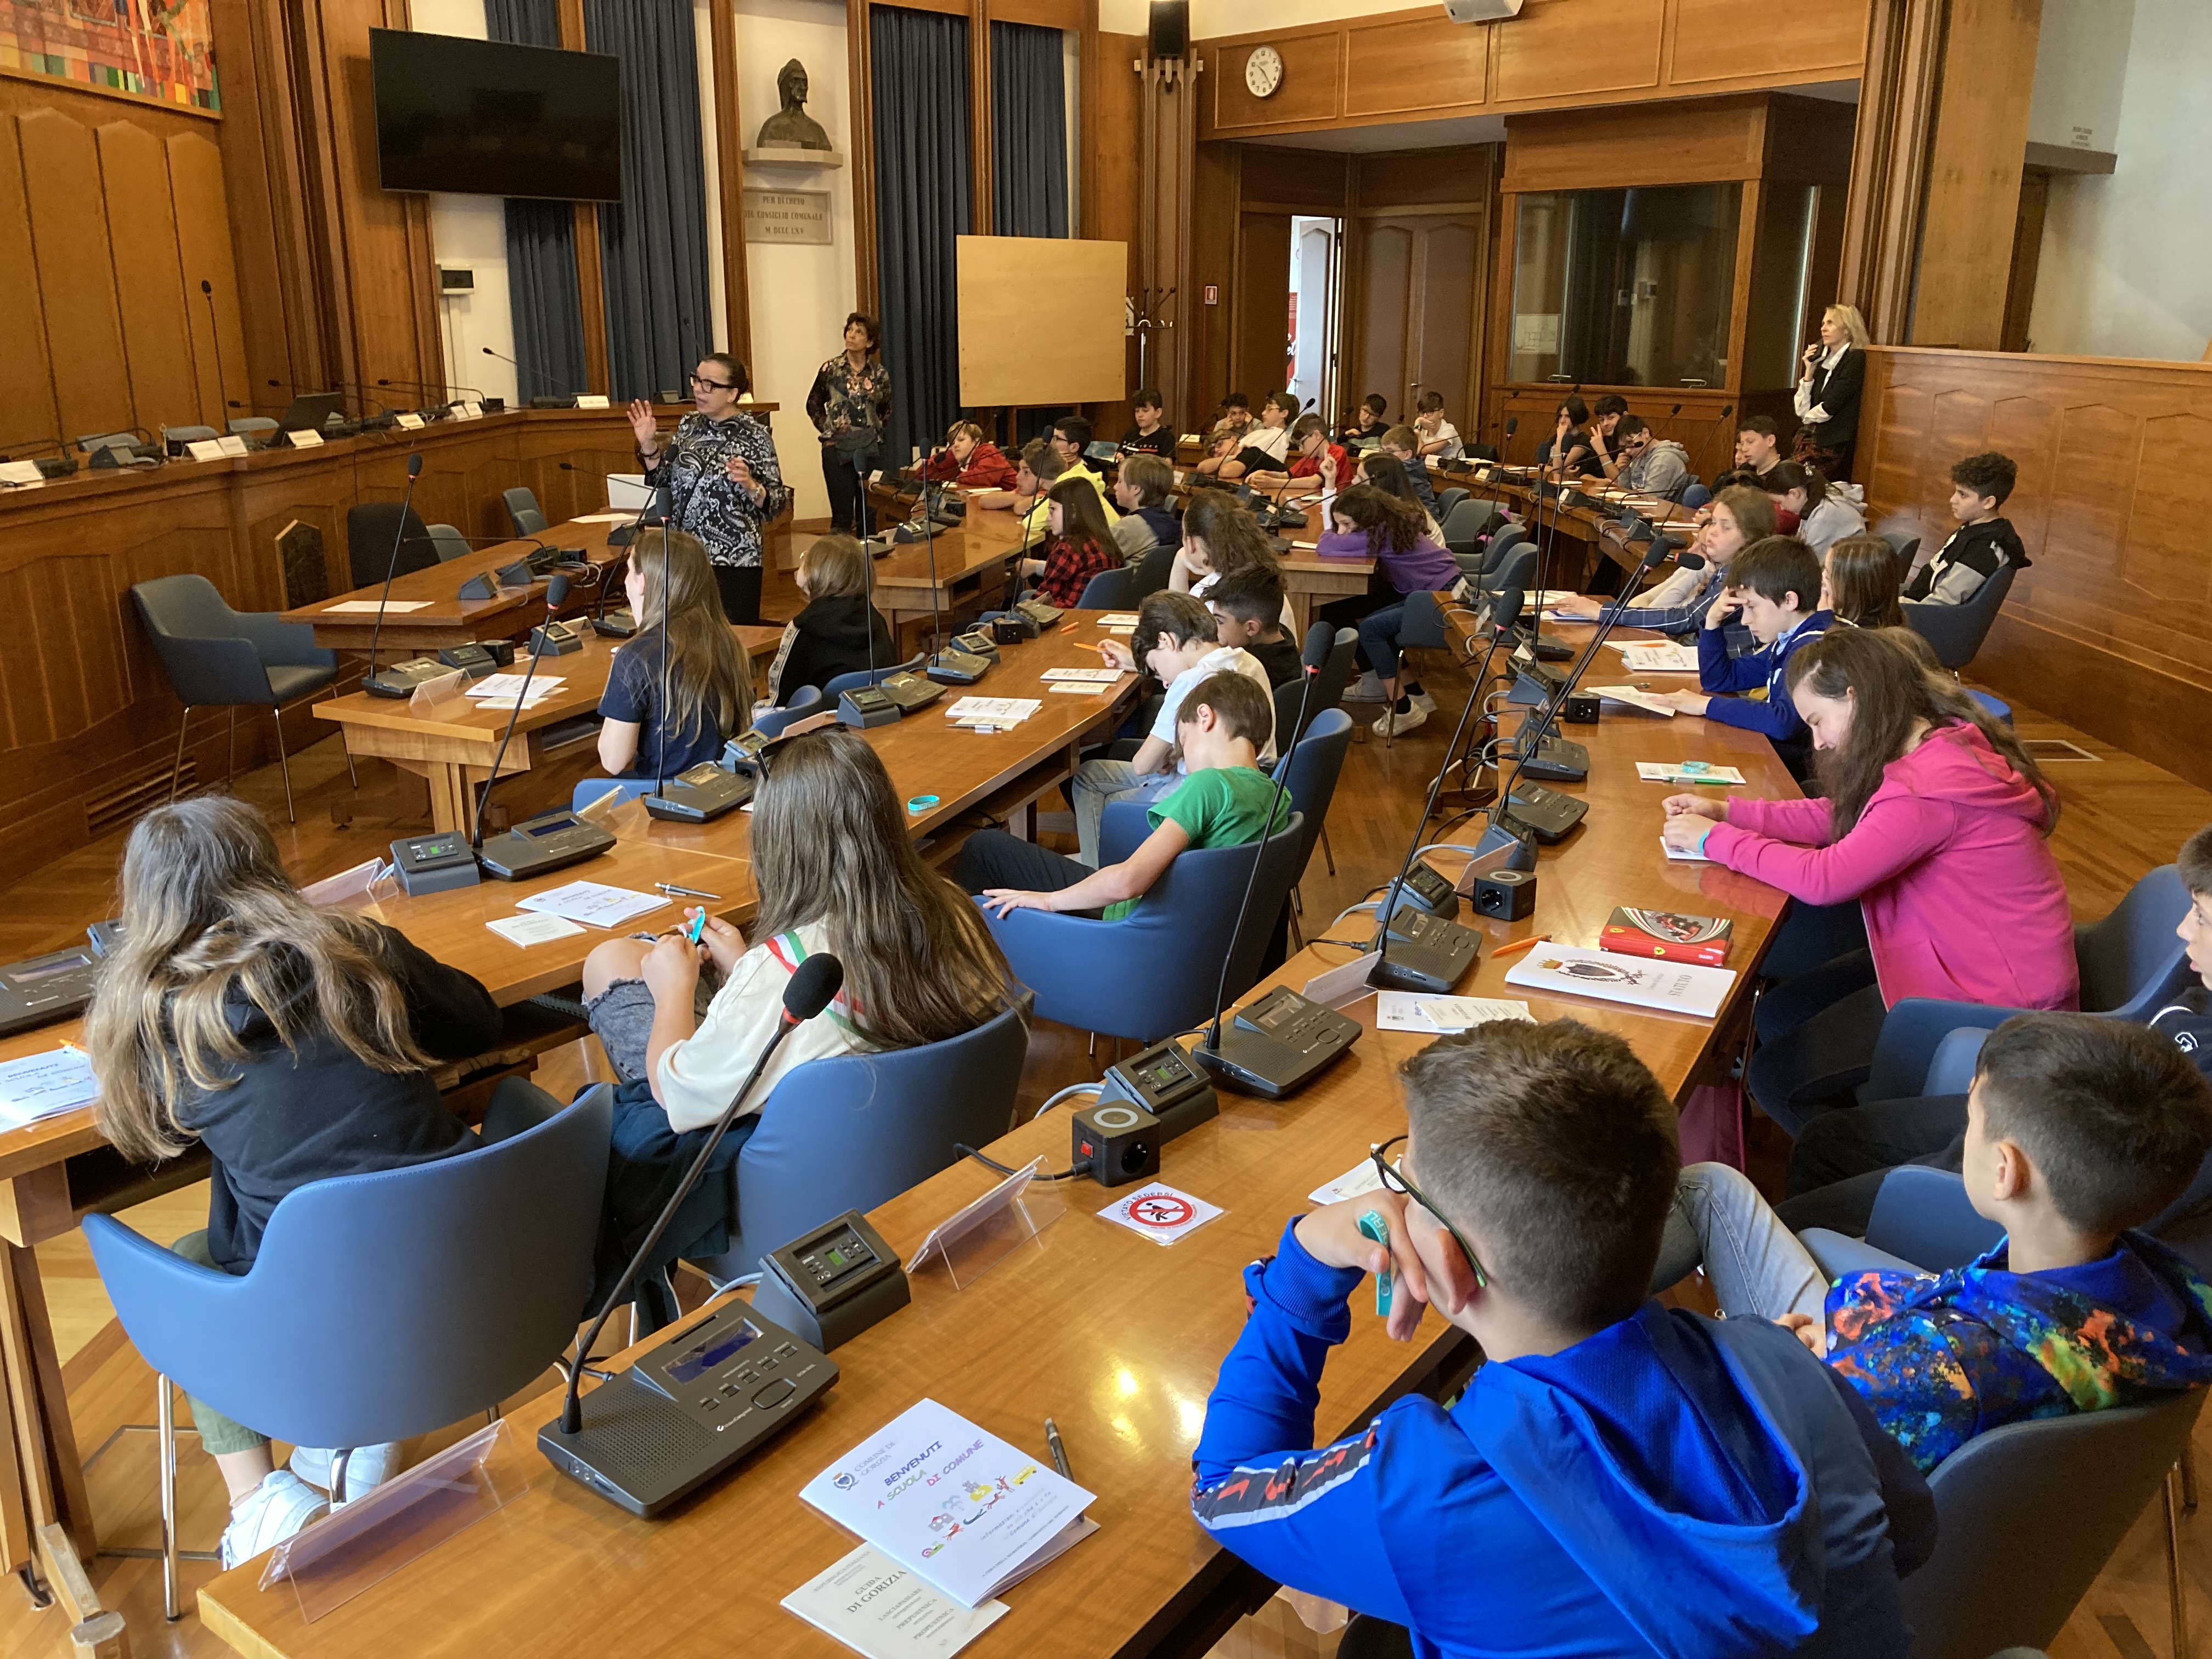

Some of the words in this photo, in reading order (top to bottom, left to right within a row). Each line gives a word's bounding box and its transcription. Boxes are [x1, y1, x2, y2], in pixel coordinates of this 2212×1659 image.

[757, 211, 788, 219] CONSIGLIO
[791, 212, 823, 221] COMUNALE
[763, 196, 776, 205] PER
[777, 196, 805, 205] DECRETO
[1668, 975, 1692, 997] STATUTO
[1121, 1200, 1134, 1221] VIETATO
[1133, 1192, 1173, 1201] SEDERSI
[854, 1447, 887, 1472] COMUNE
[885, 1441, 896, 1450] DI
[860, 1454, 893, 1476] GORIZIA
[884, 1441, 943, 1486] BENVENUTI
[926, 1473, 942, 1487] DI
[943, 1439, 984, 1475] COMUNE
[877, 1500, 885, 1509] A
[887, 1469, 927, 1501] SCUOLA
[1009, 1519, 1030, 1536] Comune
[845, 1600, 864, 1614] DI
[861, 1569, 908, 1604] GORIZIA
[855, 1575, 882, 1595] GUIDA
[877, 1587, 923, 1622] LASCIAPASSARE
[896, 1598, 939, 1630] PREPUSTNICA
[912, 1607, 955, 1641] PROPUSTNICA
